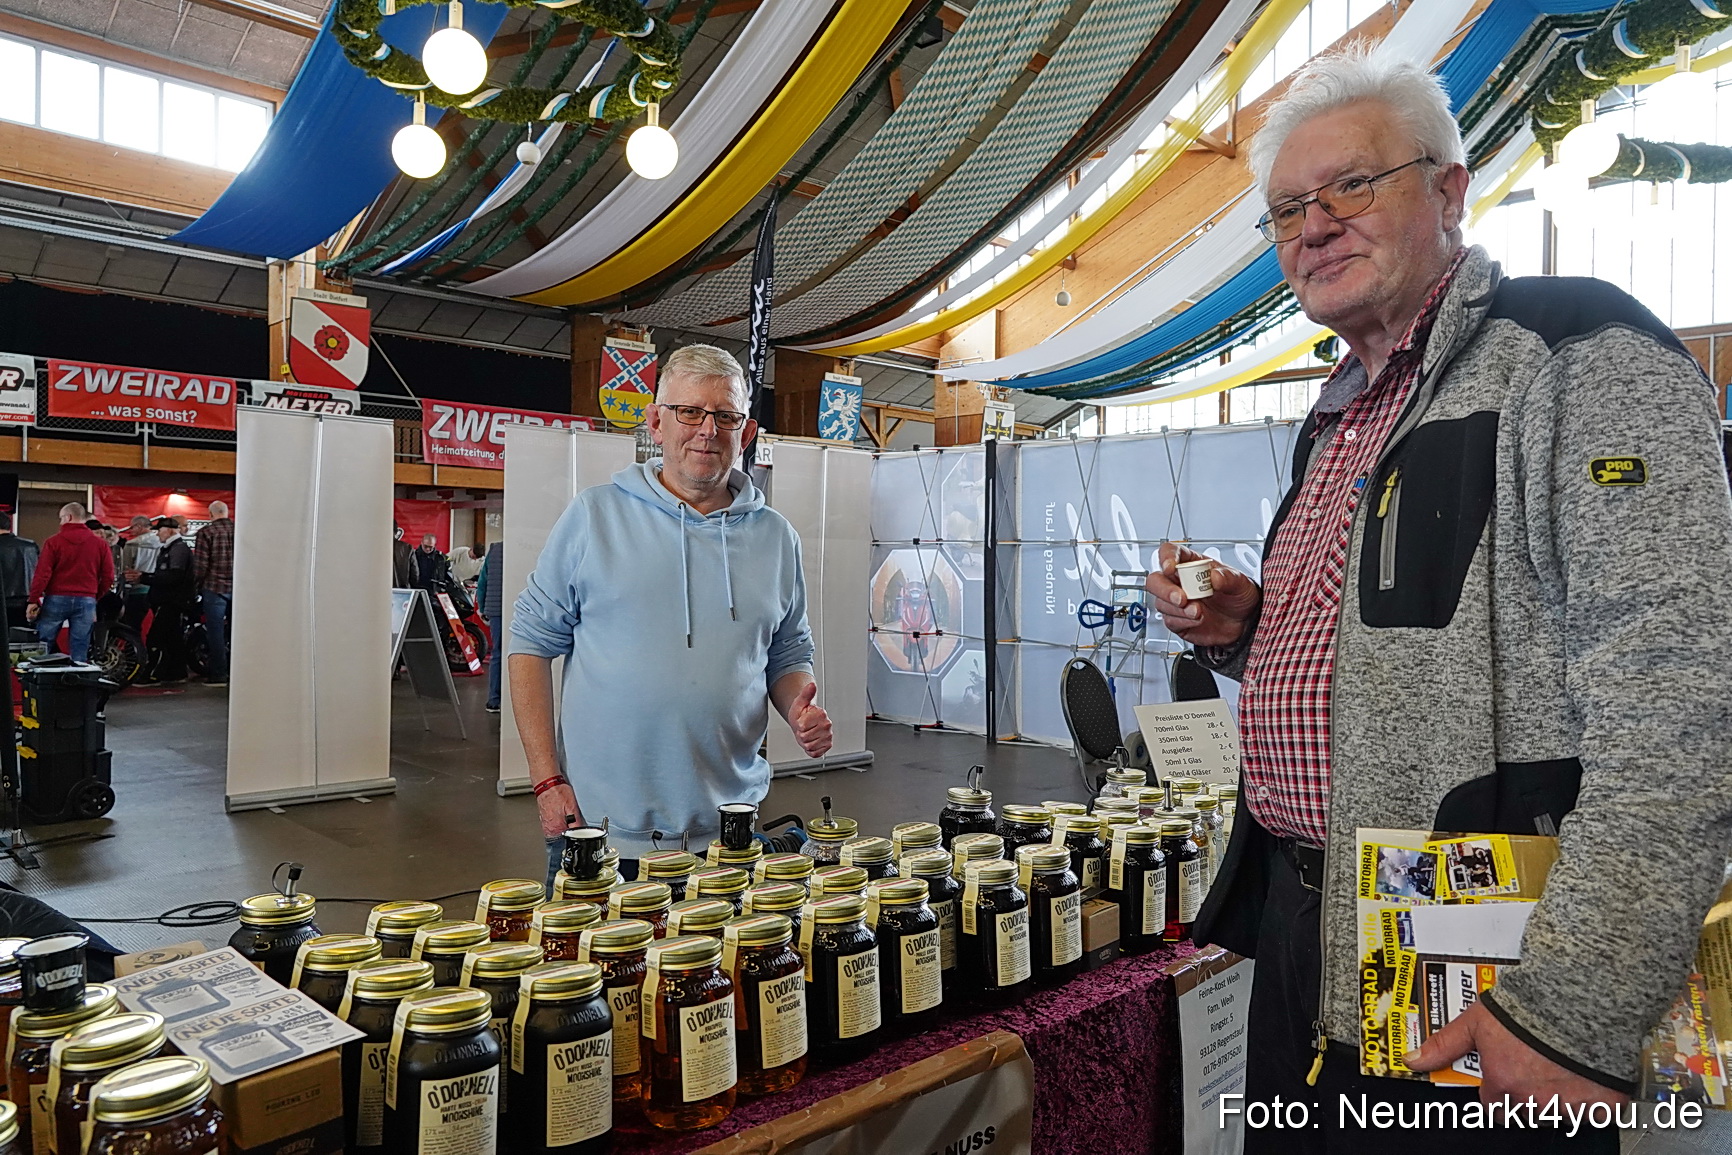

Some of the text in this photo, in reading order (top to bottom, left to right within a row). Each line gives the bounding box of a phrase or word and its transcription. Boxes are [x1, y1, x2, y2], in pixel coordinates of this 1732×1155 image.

[756, 362, 764, 384] Alles
[762, 308, 770, 335] einer
[55, 364, 232, 405] ZWEIRAD
[108, 406, 142, 418] was
[146, 407, 198, 423] sonst?
[264, 396, 351, 415] MEYER
[431, 444, 495, 462] Heimatzeitung
[1605, 460, 1634, 471] PRO
[1360, 844, 1372, 897] MOTORRAD
[1382, 912, 1396, 968] MOTORRAD
[122, 953, 230, 992] NEUE SORTE
[1198, 971, 1240, 1000] Feine-Kost Weih
[1395, 954, 1411, 1008] MOTORRAD
[1207, 993, 1234, 1016] Fam. Weih
[1364, 913, 1380, 1069] MOTORRAD Profile
[1428, 973, 1440, 1025] Bikertreff
[180, 1013, 242, 1040] NEUE
[240, 995, 293, 1018] SORTE
[686, 1002, 733, 1032] O'DONNELL
[1210, 1012, 1234, 1033] Ringstr. 5
[699, 1026, 728, 1044] MOONSHINE
[1200, 1024, 1244, 1060] 93128 Regenstauf
[1392, 1012, 1402, 1067] MOTORRAD
[553, 1038, 611, 1071] O'DONNELL
[1203, 1044, 1242, 1076] 0176-97875620
[566, 1066, 602, 1084] MOONSHINE
[428, 1075, 496, 1110] O'DONNELL
[442, 1105, 484, 1124] MOONSHINE
